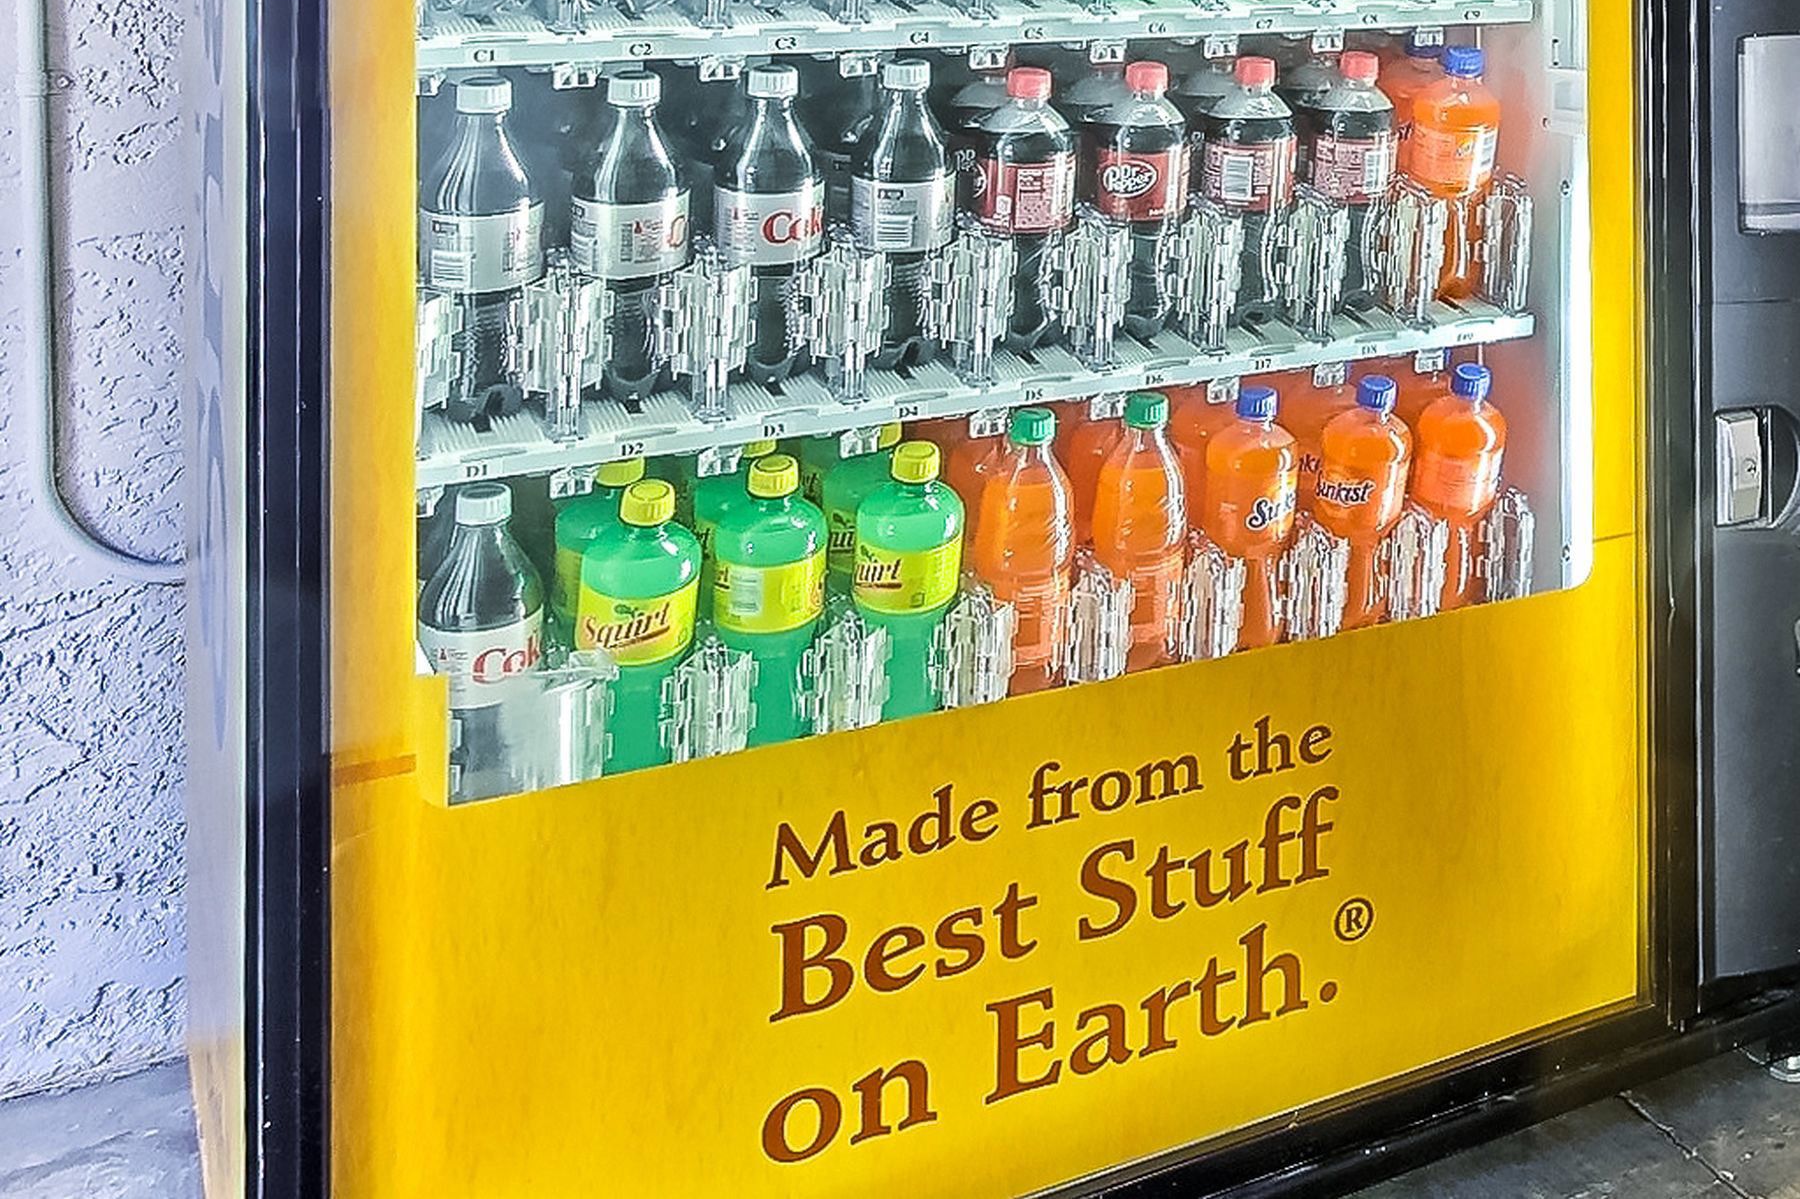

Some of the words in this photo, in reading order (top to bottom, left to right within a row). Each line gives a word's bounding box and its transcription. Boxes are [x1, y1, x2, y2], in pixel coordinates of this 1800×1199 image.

[1148, 22, 1167, 35] C6
[1255, 18, 1273, 30] C7
[909, 30, 930, 45] C4
[1024, 27, 1045, 41] C5
[629, 42, 653, 57] C2
[774, 36, 796, 51] C3
[473, 48, 496, 63] C1
[1255, 358, 1273, 371] D7
[1146, 373, 1164, 386] D6
[1025, 388, 1043, 401] D5
[898, 405, 919, 419] D4
[764, 423, 785, 437] D3
[621, 441, 645, 456] D2
[466, 463, 489, 478] D1
[581, 602, 672, 651] Squirt
[766, 785, 1000, 891] Made
[1026, 753, 1204, 829] from
[1225, 715, 1334, 781] the
[768, 881, 1041, 1024] Best
[1077, 786, 1341, 942] Stuff
[761, 1059, 938, 1164] on
